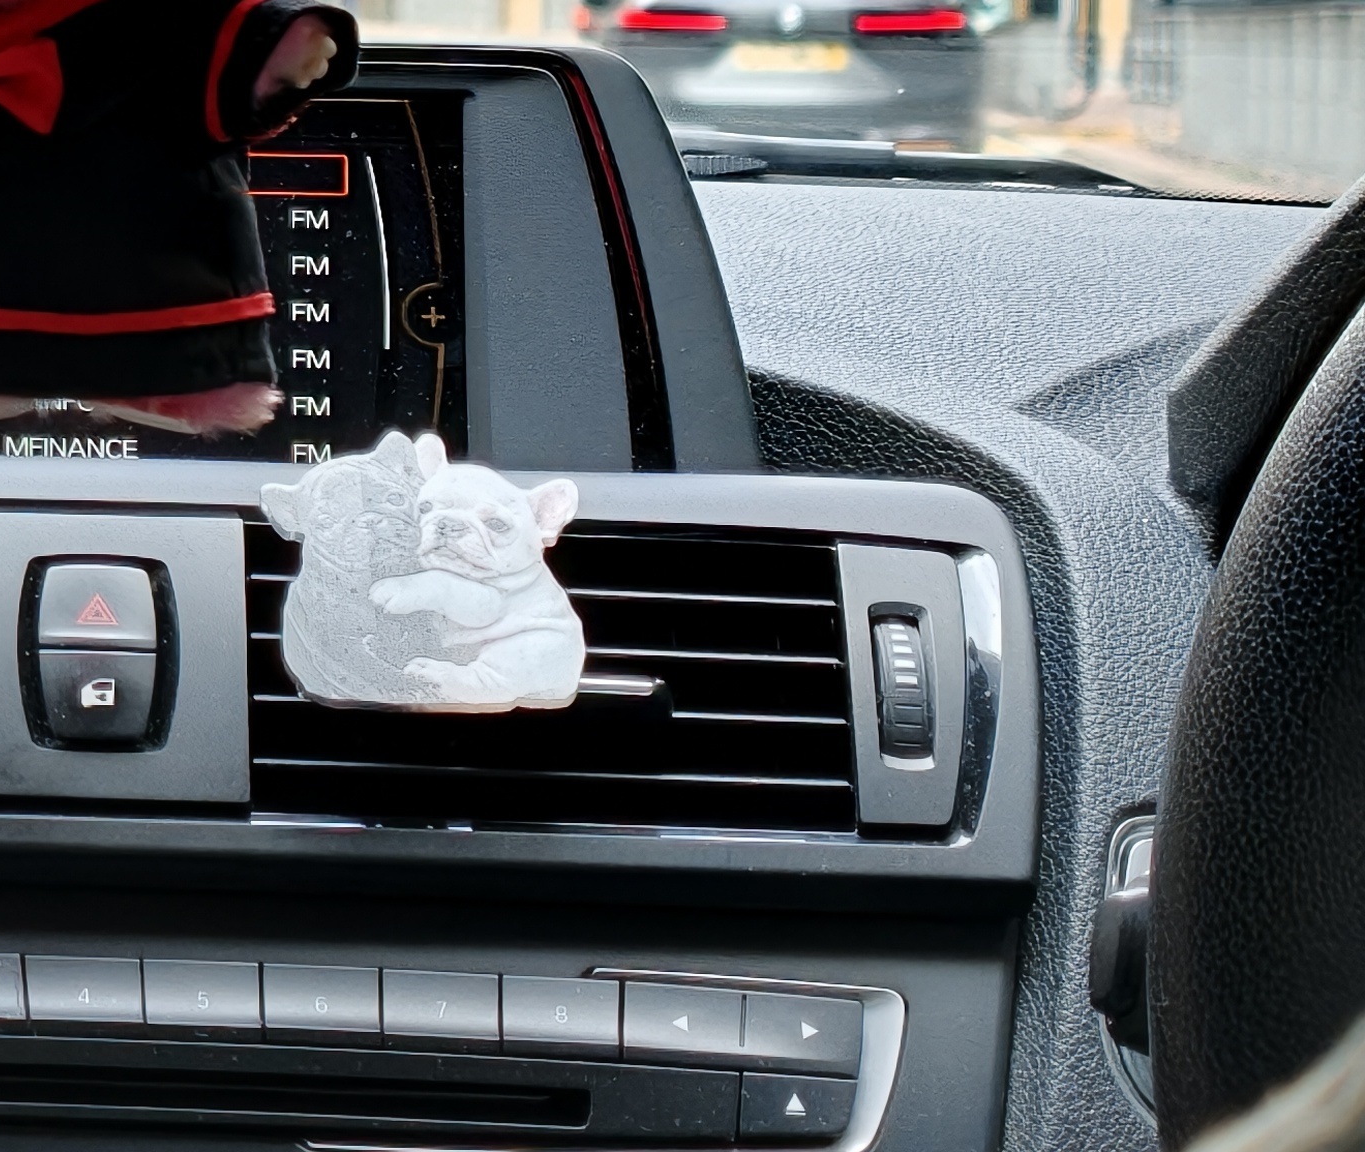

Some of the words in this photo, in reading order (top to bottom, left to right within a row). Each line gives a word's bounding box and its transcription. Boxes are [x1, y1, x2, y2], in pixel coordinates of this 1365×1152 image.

[291, 210, 330, 229] FM
[291, 256, 330, 275] FM
[291, 303, 330, 322] FM
[291, 350, 330, 369] FM
[291, 397, 330, 416] FM
[4, 436, 140, 459] MFINANCE
[292, 444, 332, 464] FM
[77, 987, 91, 1005] 4
[197, 990, 210, 1010] 5
[314, 996, 329, 1015] 6
[436, 1000, 448, 1019] 7
[554, 1005, 569, 1024] 8
